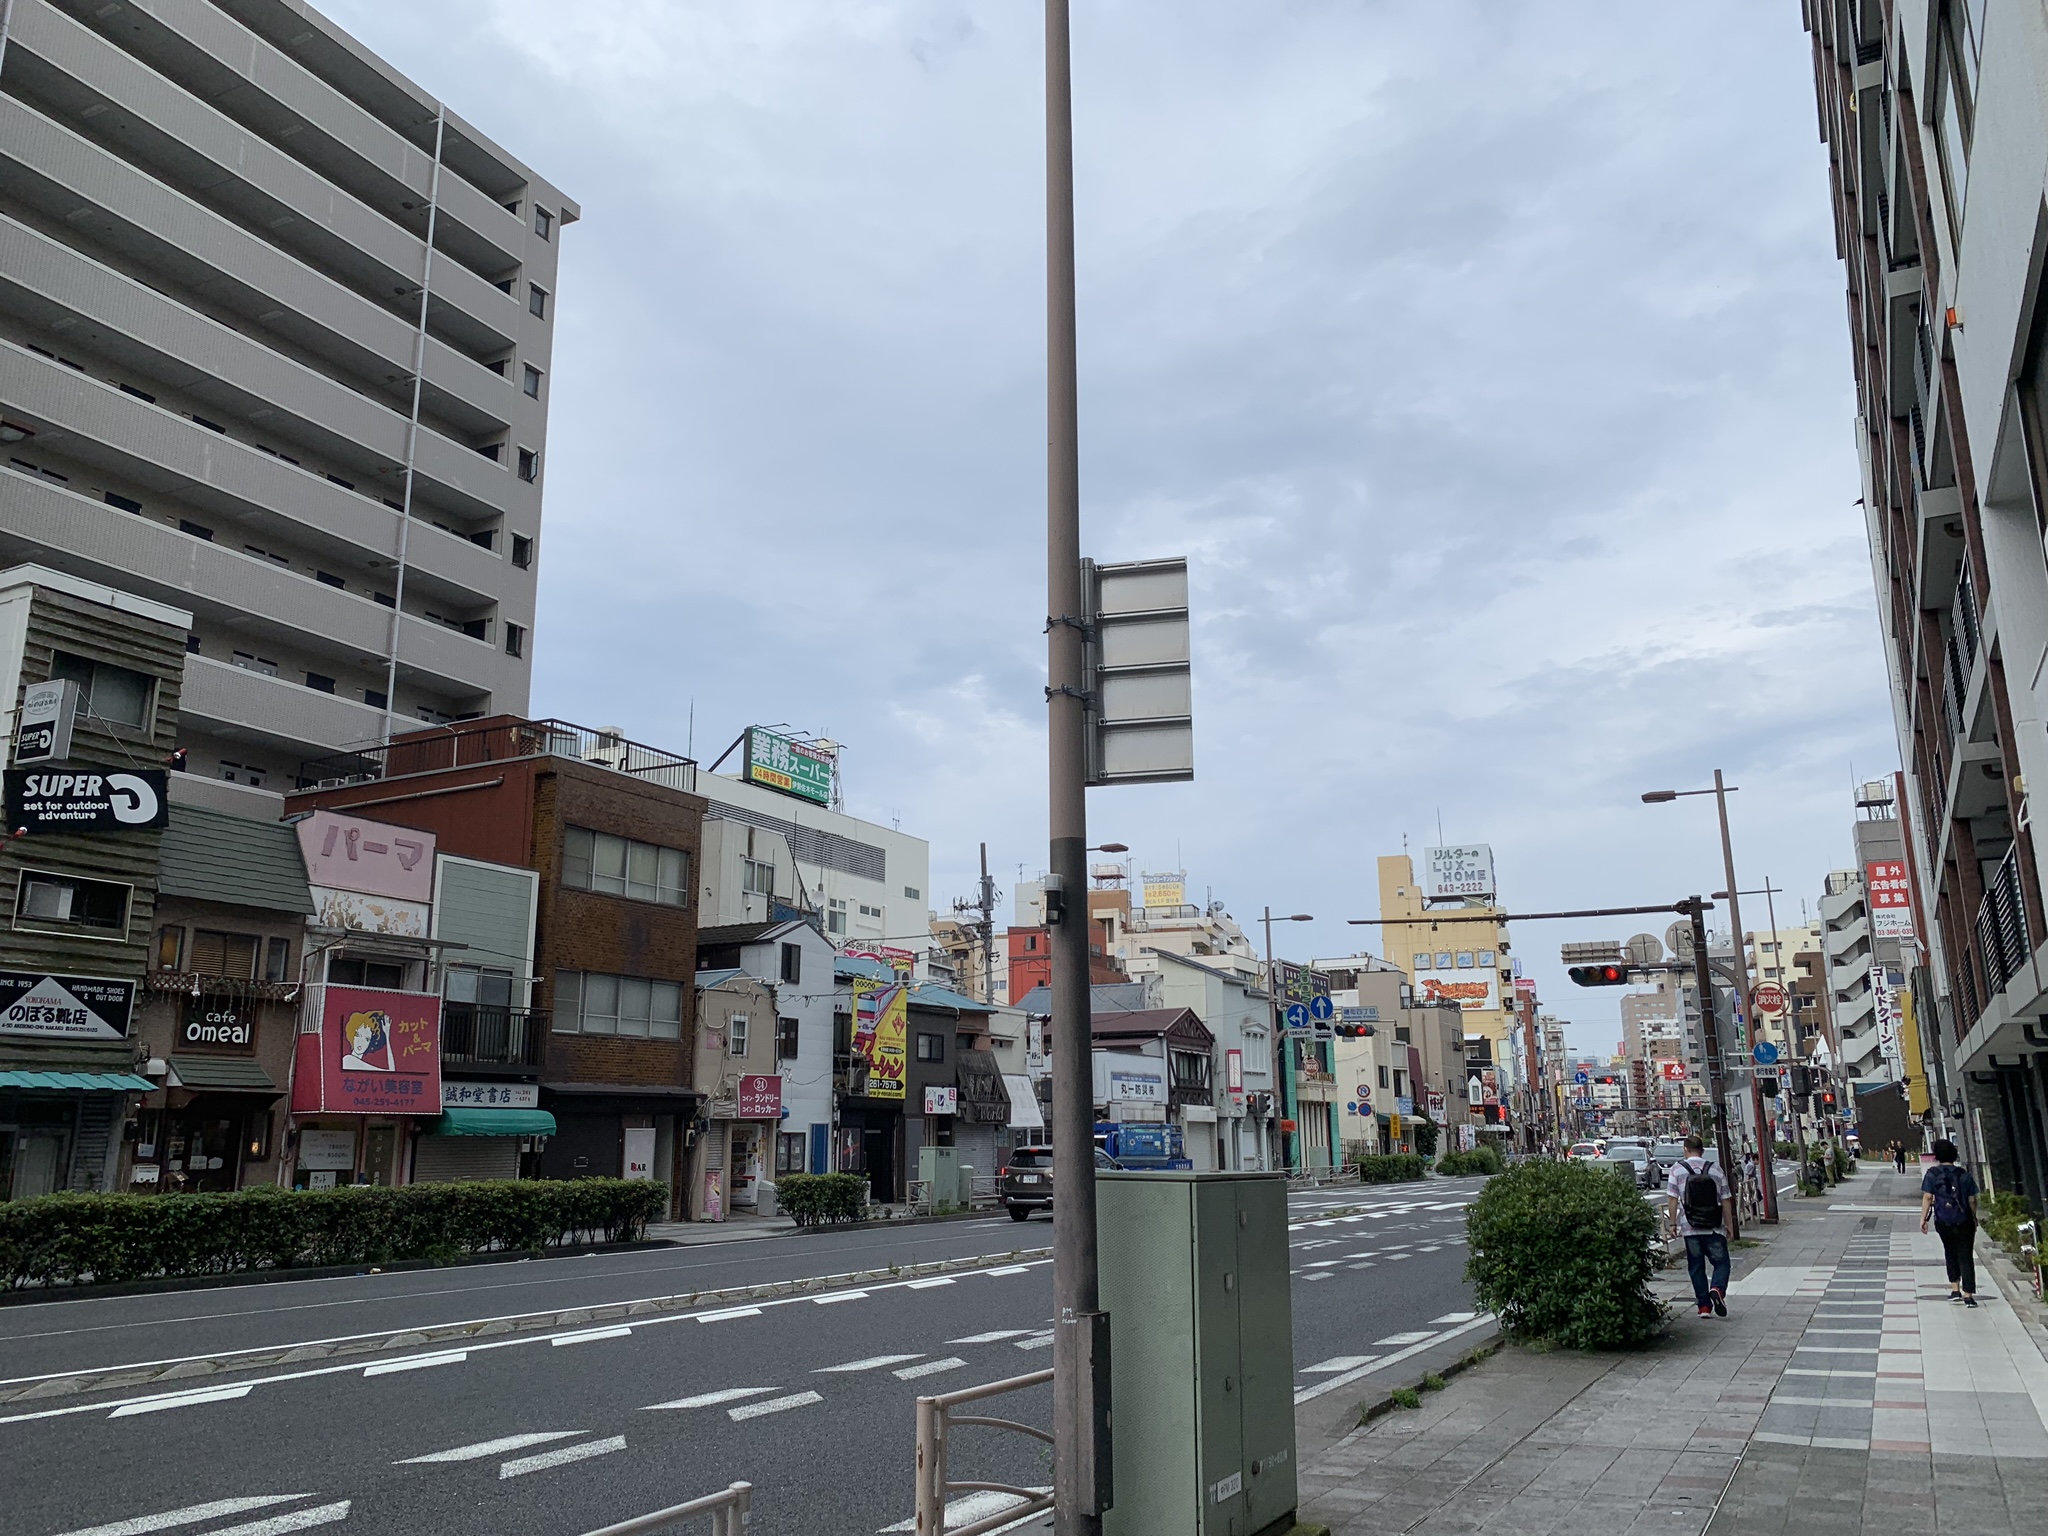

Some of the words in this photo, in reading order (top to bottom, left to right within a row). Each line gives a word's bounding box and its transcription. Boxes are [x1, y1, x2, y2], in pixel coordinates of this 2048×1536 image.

[752, 732, 829, 781] 業務スーパー
[754, 767, 790, 787] 24時間営業
[22, 775, 103, 797] SUPER
[23, 801, 43, 811] set
[46, 801, 63, 811] for
[67, 800, 110, 811] outdoor
[38, 811, 97, 820] adventure
[321, 825, 424, 871] パーマ
[1433, 860, 1475, 872] LUX-
[1443, 870, 1486, 882] HOME
[1437, 882, 1483, 893] 843-2222
[1871, 879, 1908, 890] 広告看板
[0, 979, 14, 987] INCE
[18, 980, 33, 988] 1953
[72, 985, 104, 994] HANDMADE
[106, 987, 125, 995] SHOES
[1758, 994, 1782, 1005] 消火栓
[1872, 967, 1893, 1044] ゴールドクイーン
[9, 1005, 88, 1026] のぼる靴店
[206, 1011, 236, 1023] cafe
[399, 1018, 429, 1033] カット
[413, 1033, 421, 1043] &
[402, 1041, 432, 1057] パーマ
[343, 1078, 423, 1096] ながい美容室
[756, 1079, 765, 1090] 24
[445, 1086, 512, 1103] 誠和堂書店
[979, 1104, 1004, 1121] World
[630, 1162, 646, 1172] BAR
